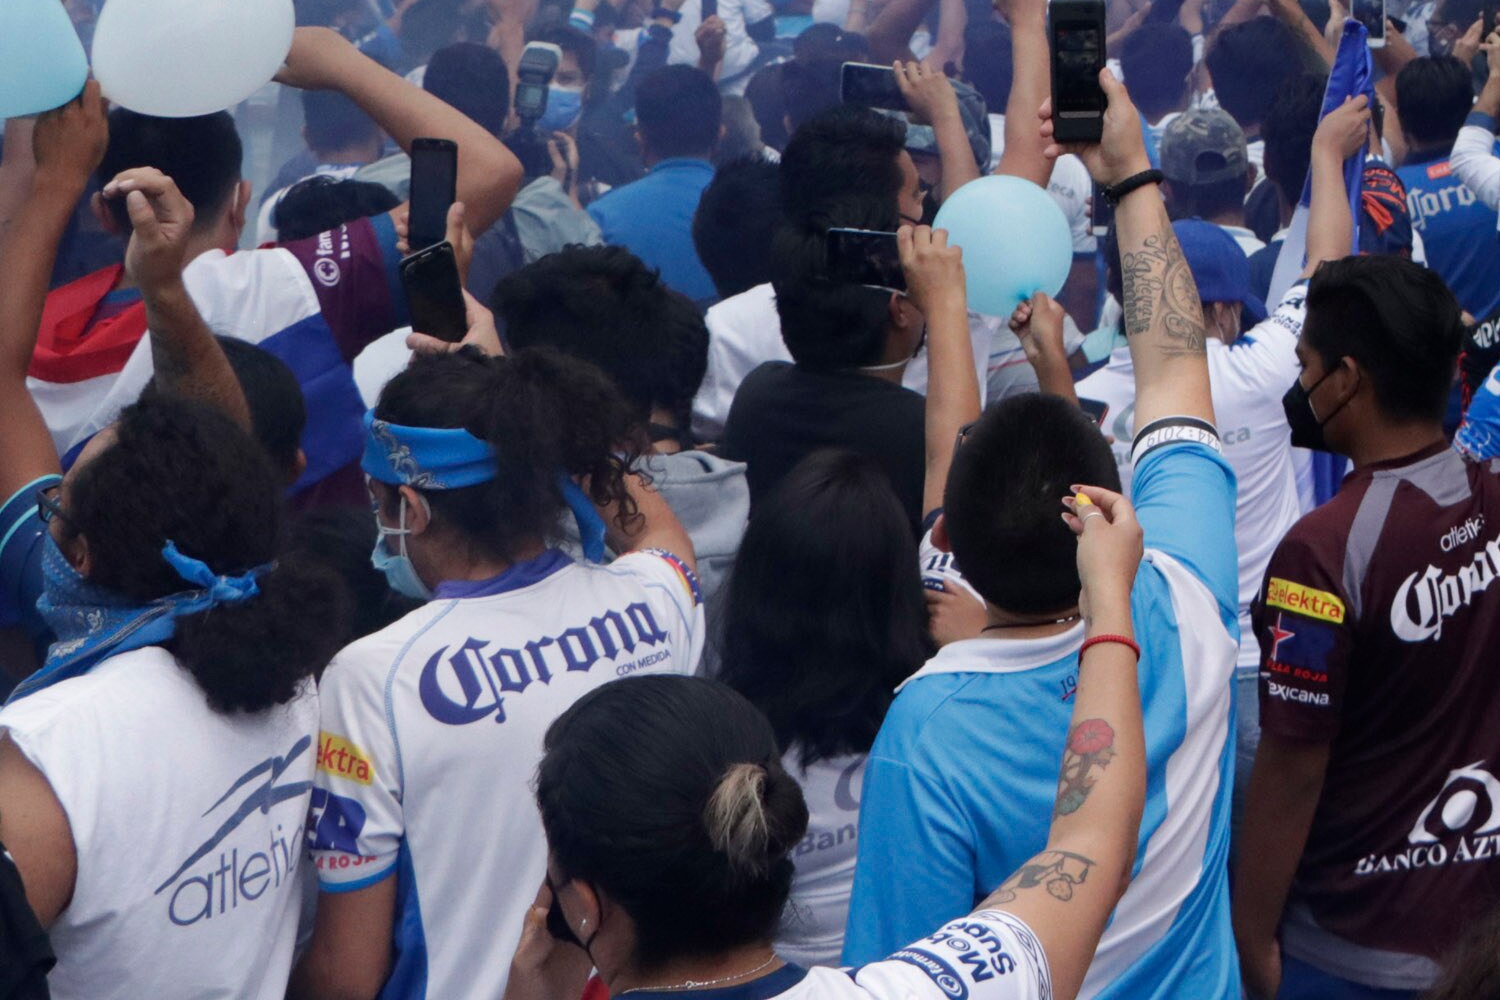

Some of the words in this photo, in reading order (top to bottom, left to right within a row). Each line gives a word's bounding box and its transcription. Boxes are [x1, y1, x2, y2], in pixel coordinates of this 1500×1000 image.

[419, 602, 668, 726] Corona
[616, 660, 637, 677] CON
[640, 648, 672, 672] MEDIDA
[1354, 843, 1448, 875] BANCO
